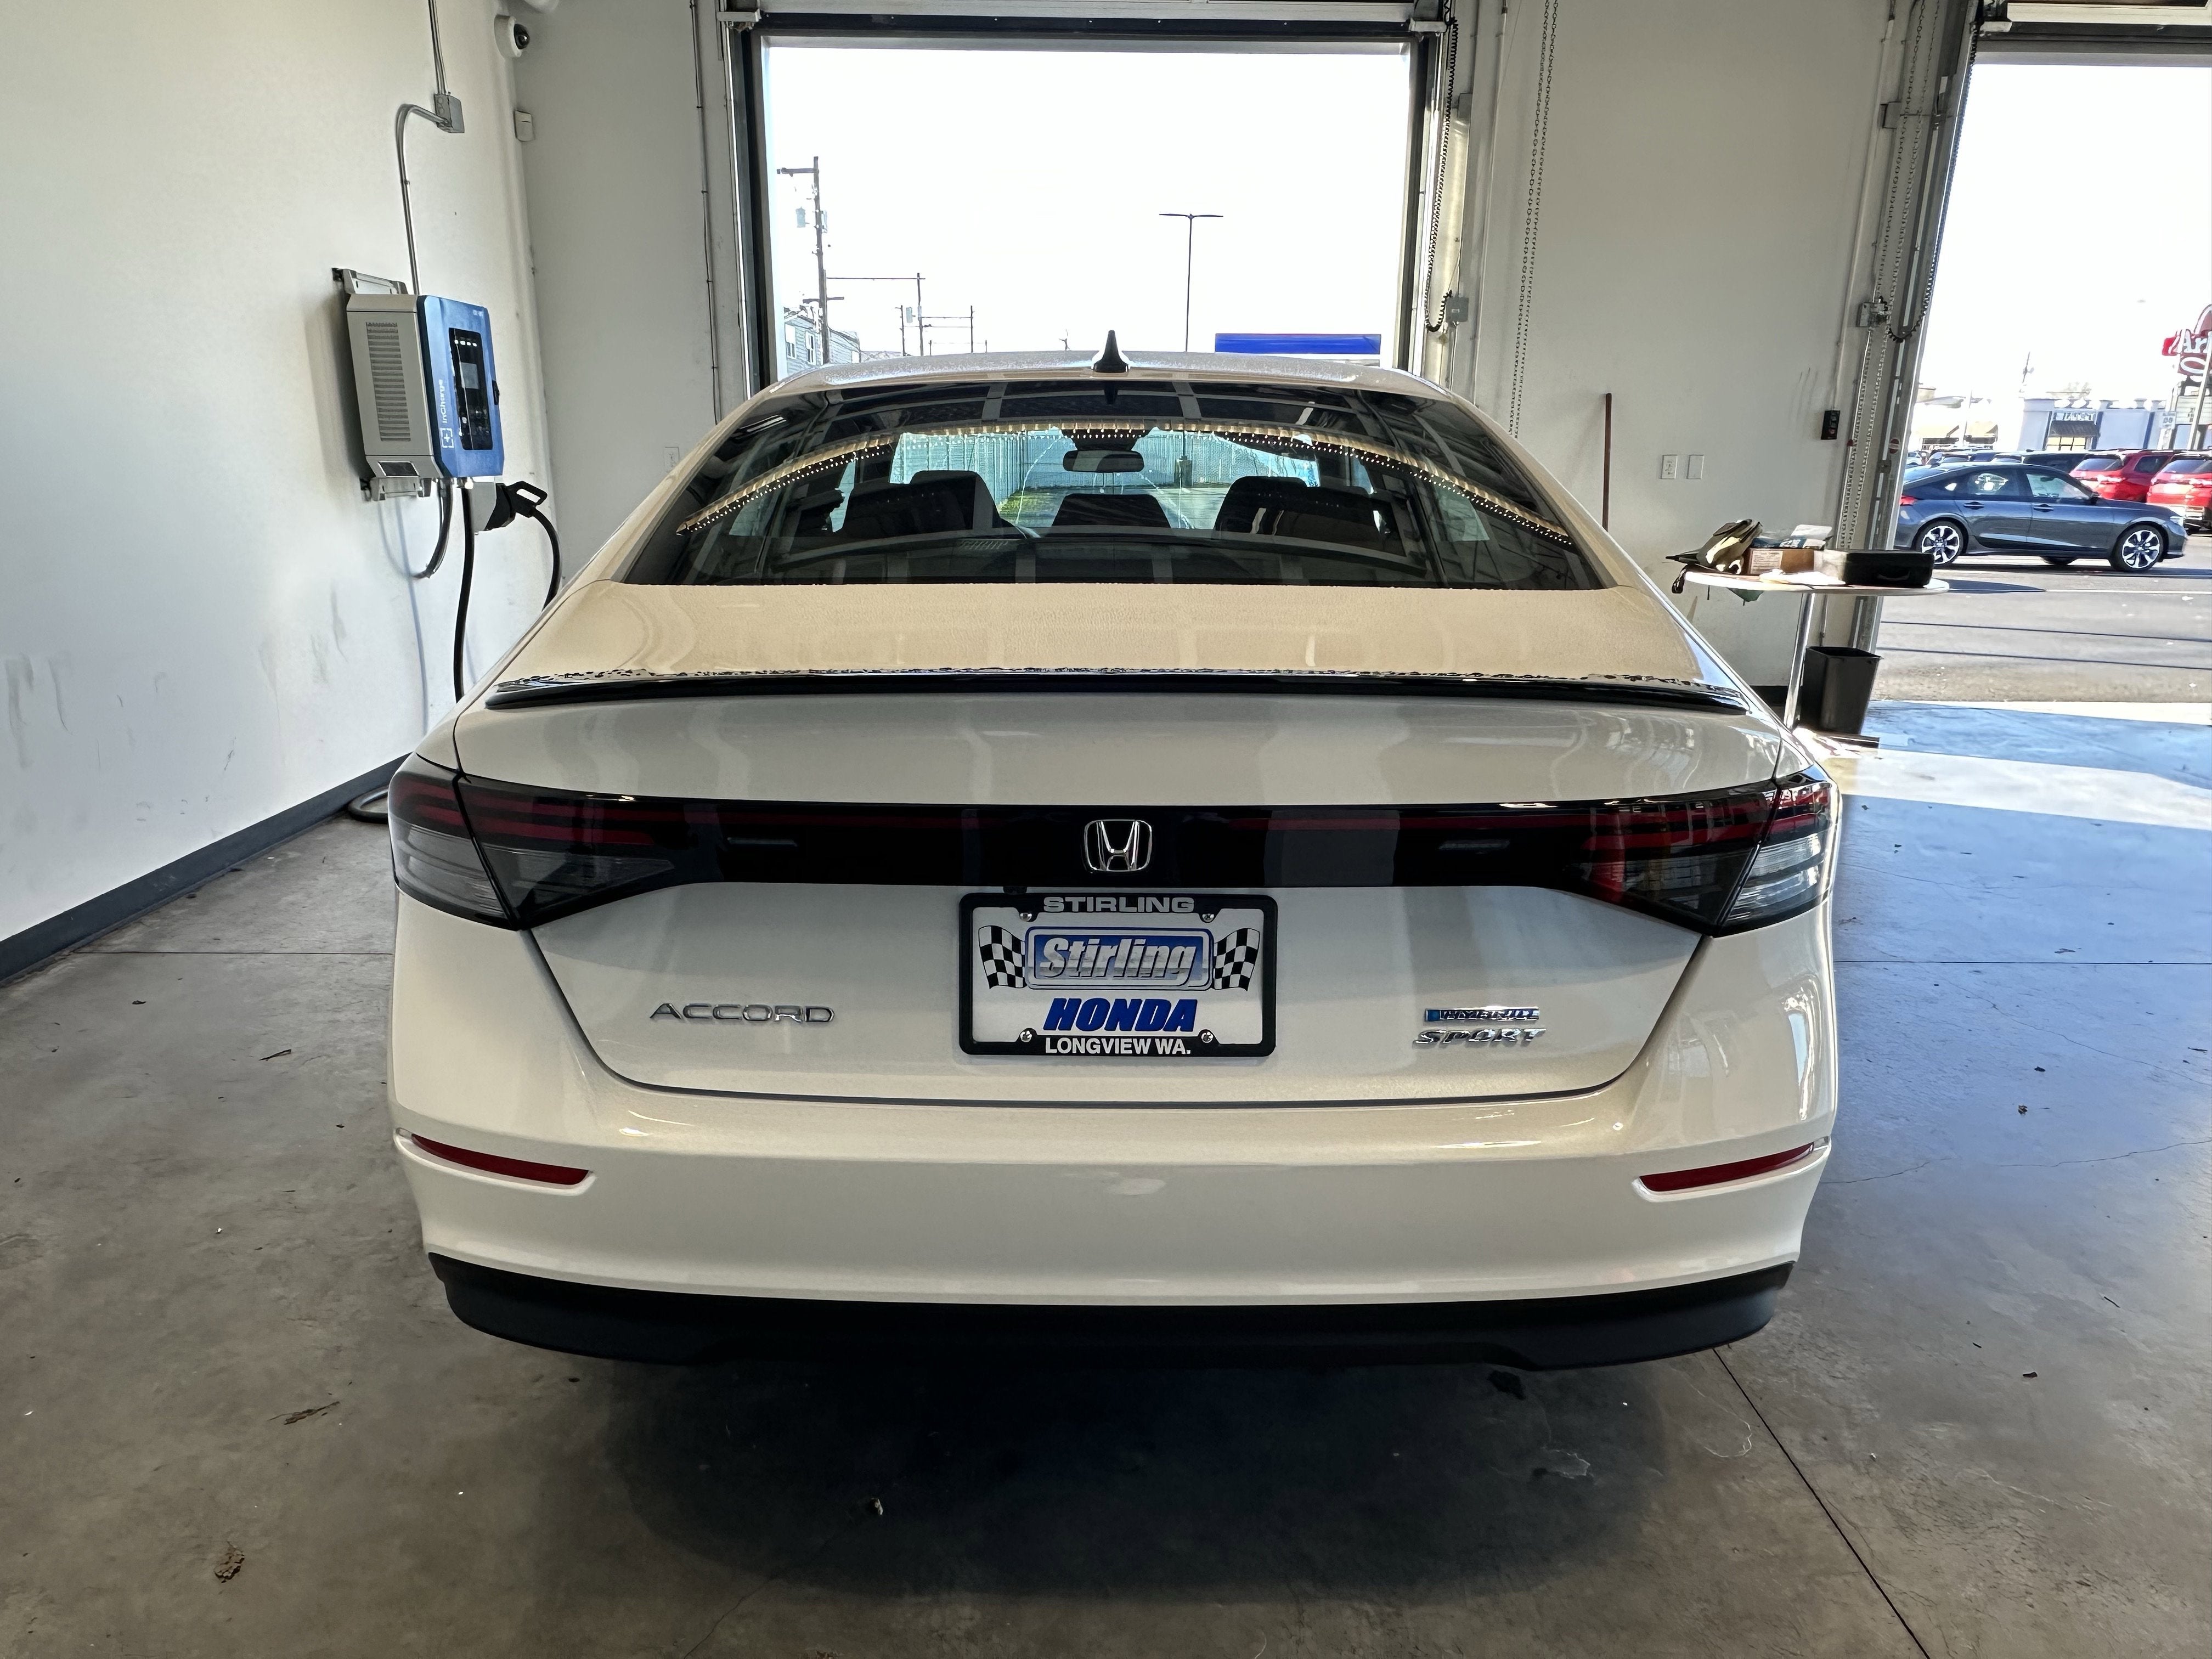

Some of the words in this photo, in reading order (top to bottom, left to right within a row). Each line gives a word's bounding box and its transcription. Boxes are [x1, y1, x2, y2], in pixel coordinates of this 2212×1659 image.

[1043, 896, 1195, 913] STIRLING
[1039, 936, 1197, 985] Stirling
[650, 1002, 835, 1023] ACCORD
[1043, 997, 1198, 1032] HONDA
[1045, 1037, 1152, 1054] LONGVIEW
[1154, 1037, 1191, 1054] WA.
[1414, 1028, 1547, 1044] SPORT
